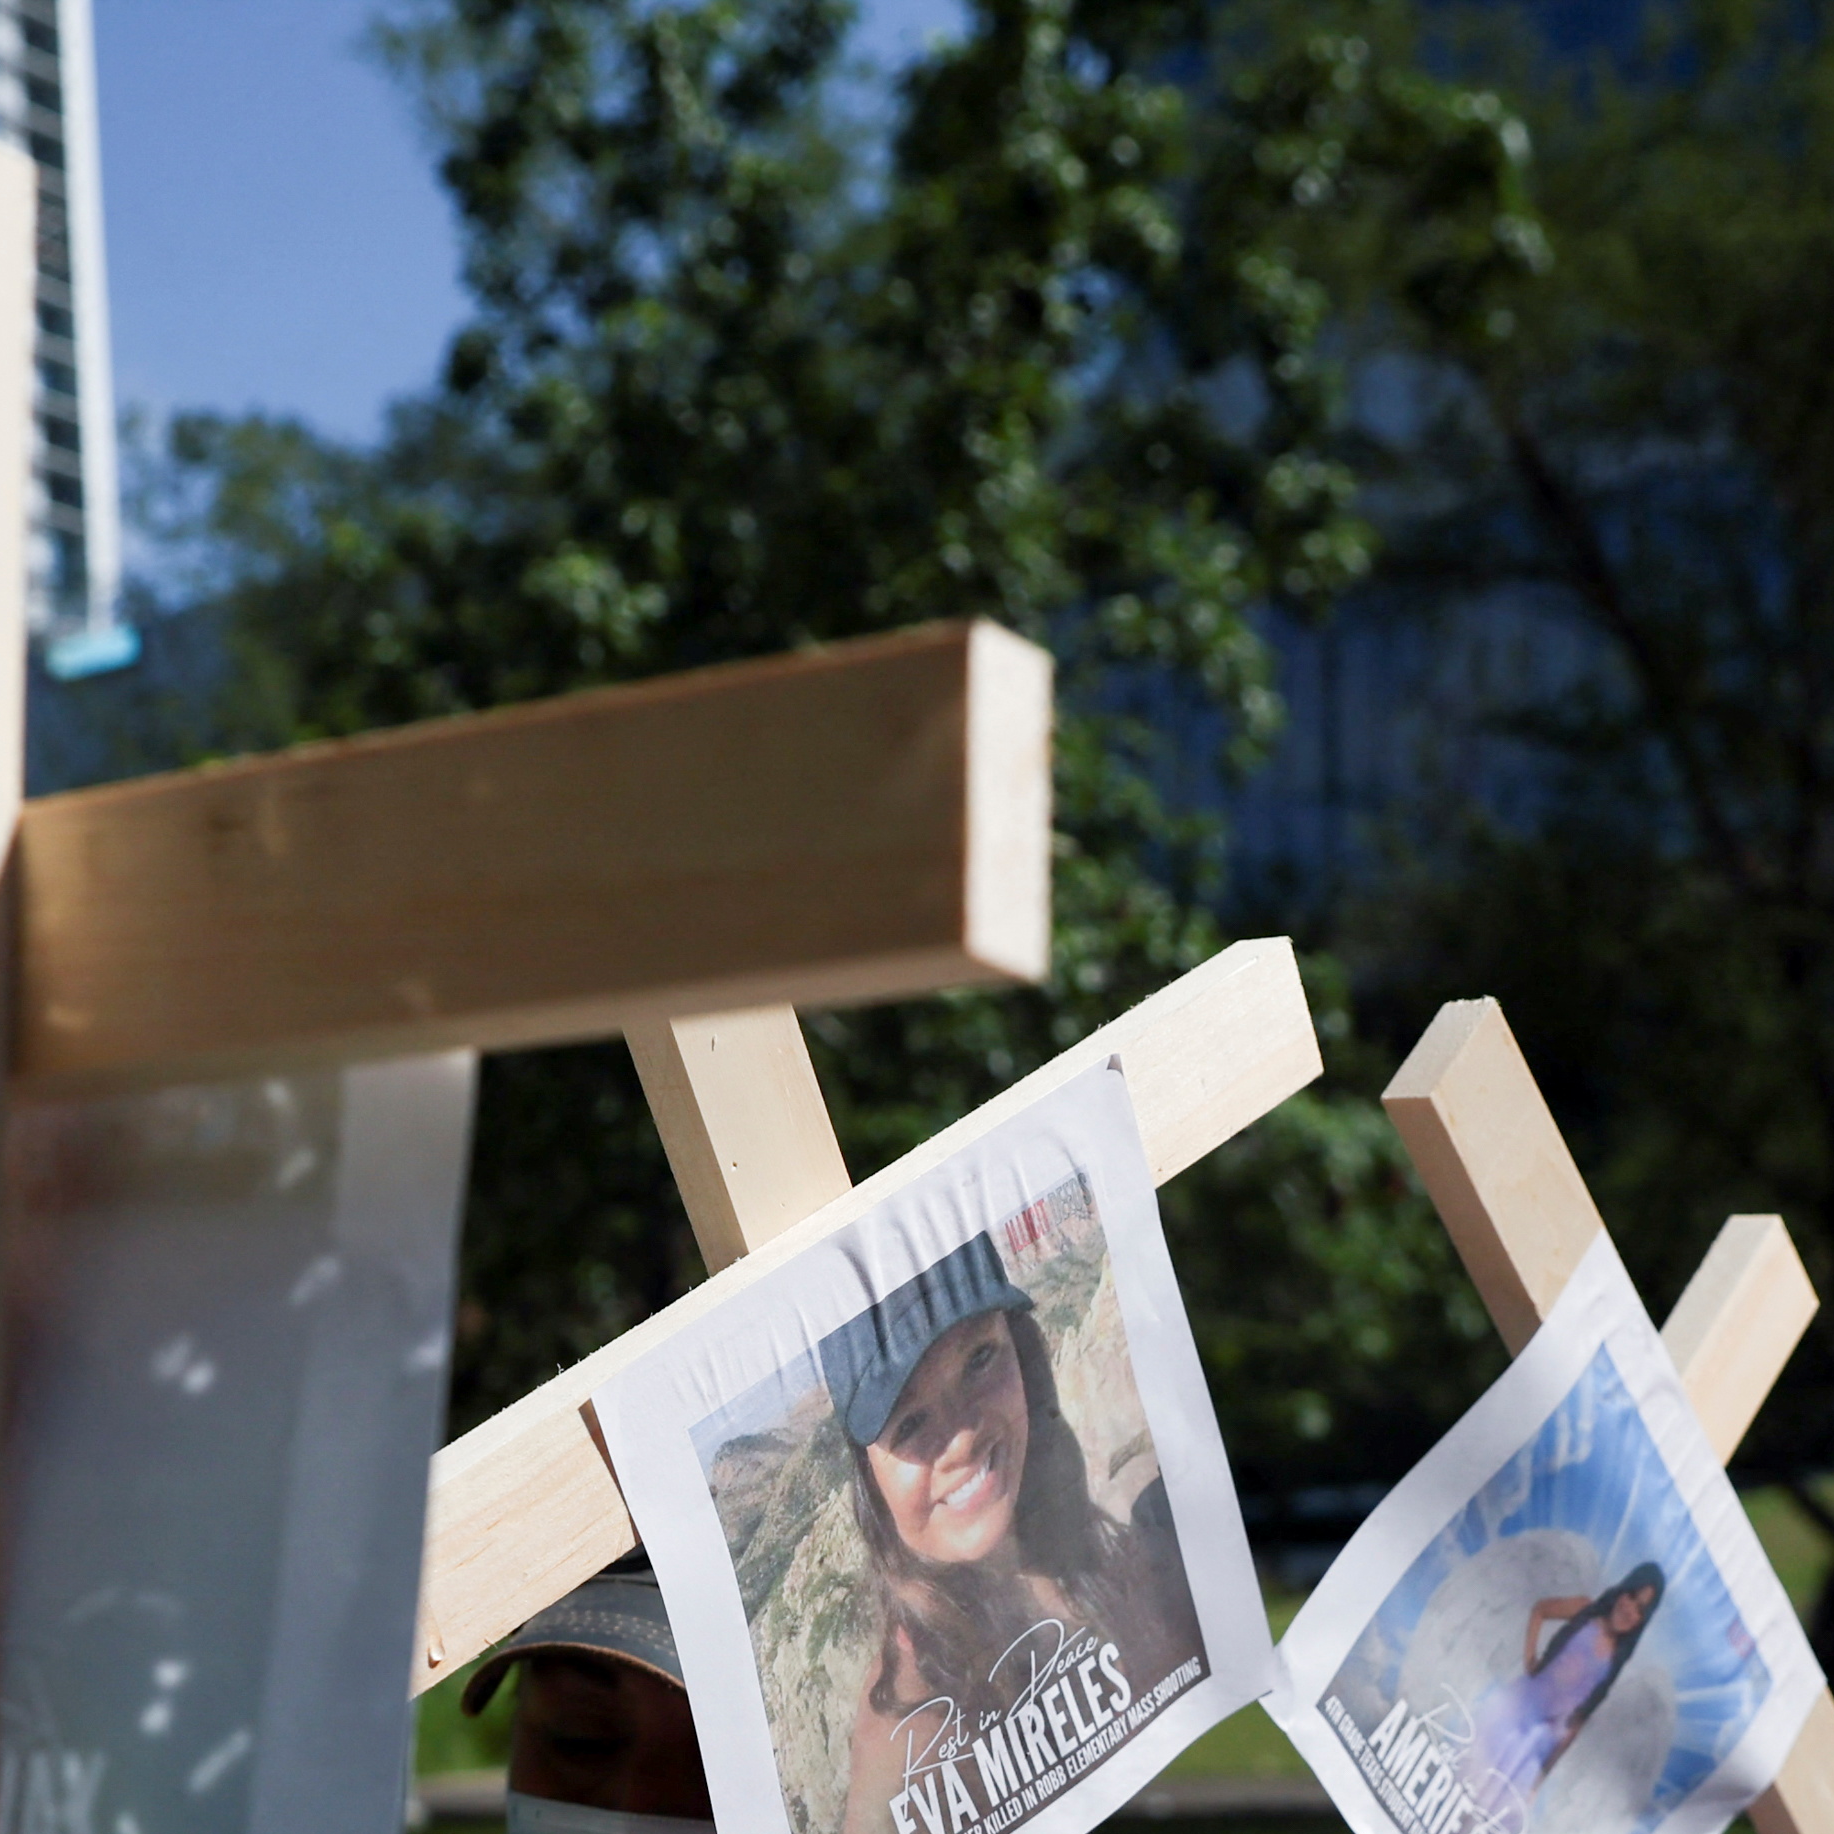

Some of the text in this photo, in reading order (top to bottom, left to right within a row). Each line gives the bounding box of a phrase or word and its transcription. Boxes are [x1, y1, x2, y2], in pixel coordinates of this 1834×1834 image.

[889, 1618, 1098, 1818] Rest in Peace
[971, 1642, 1132, 1808] MIRELES
[1021, 1792, 1039, 1812] IN
[1035, 1764, 1067, 1801] ROBB
[1064, 1718, 1129, 1780] ELEMENTARY
[1124, 1692, 1155, 1730] MASS
[1152, 1656, 1202, 1708] SHOOTING
